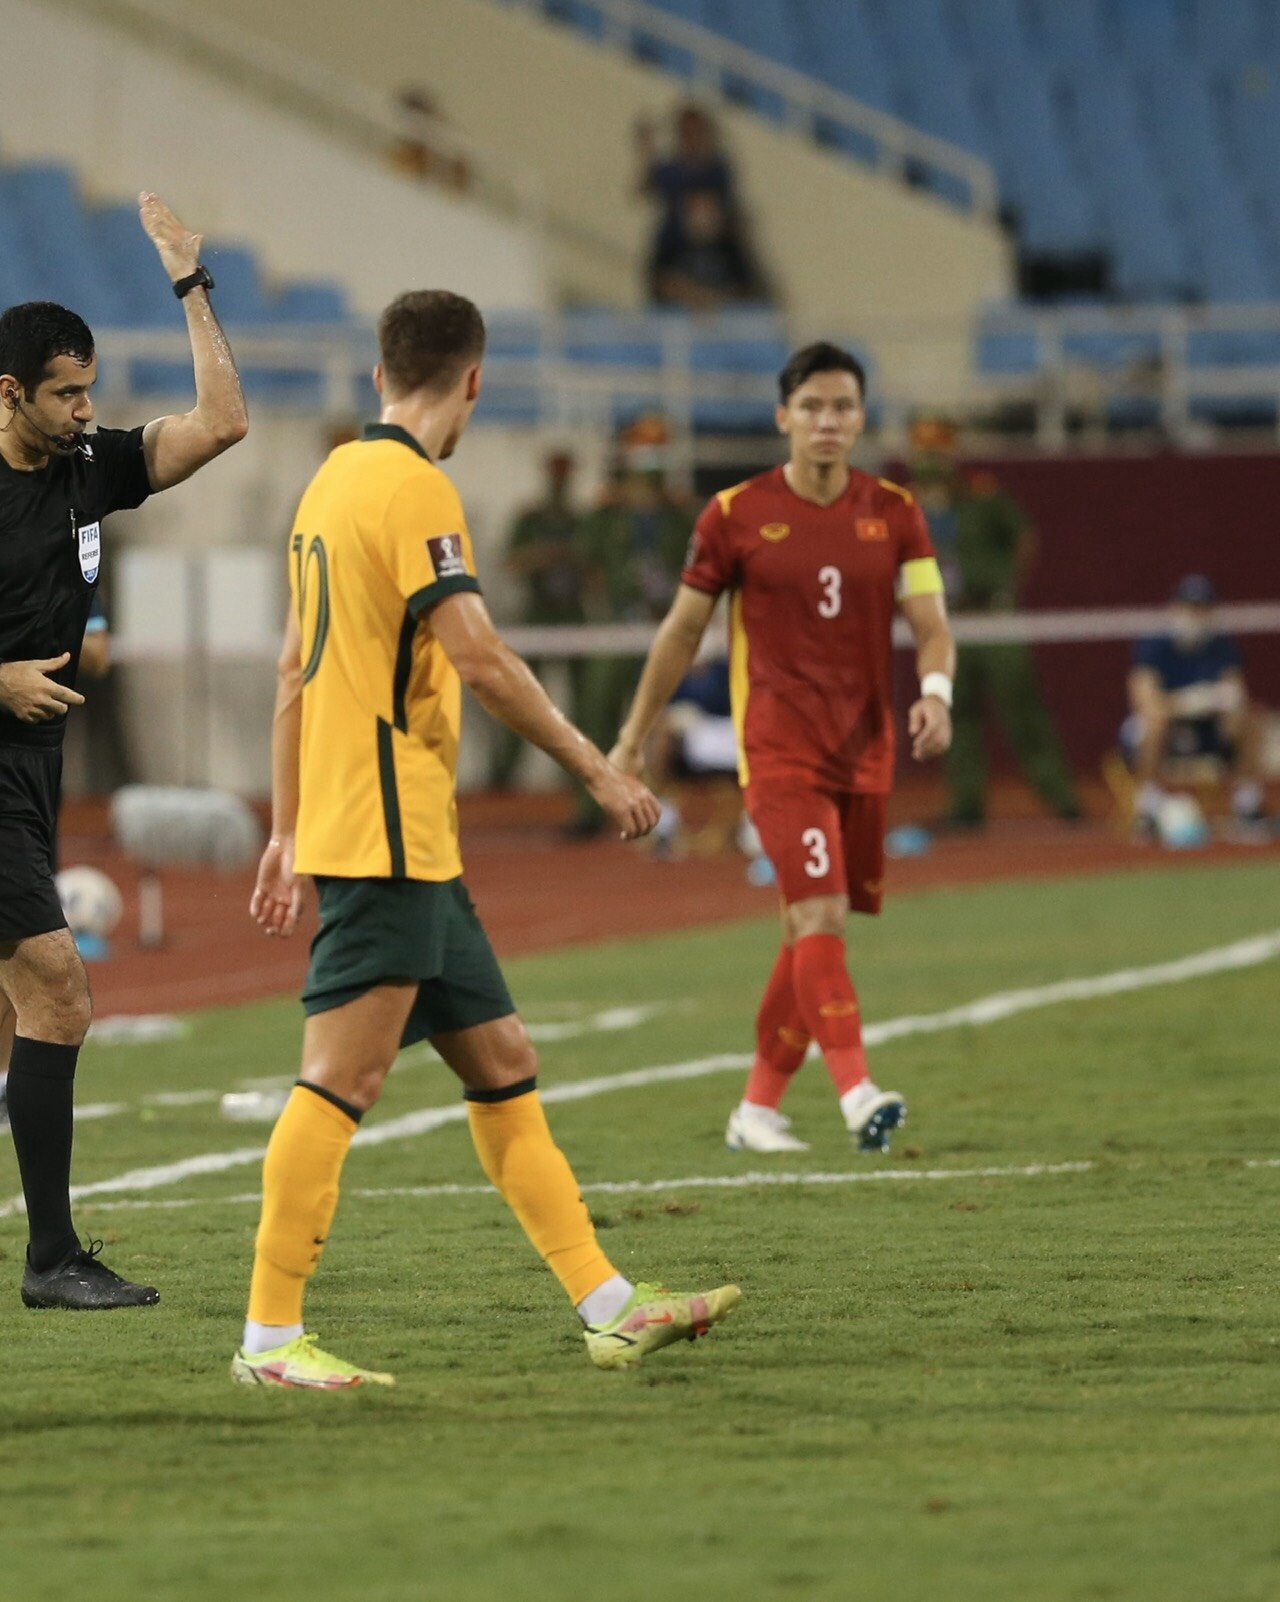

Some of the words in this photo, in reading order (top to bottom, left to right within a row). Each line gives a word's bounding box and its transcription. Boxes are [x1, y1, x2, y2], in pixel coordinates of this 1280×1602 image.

[81, 526, 98, 544] FIFA
[817, 564, 842, 619] 3
[801, 827, 830, 879] 3
